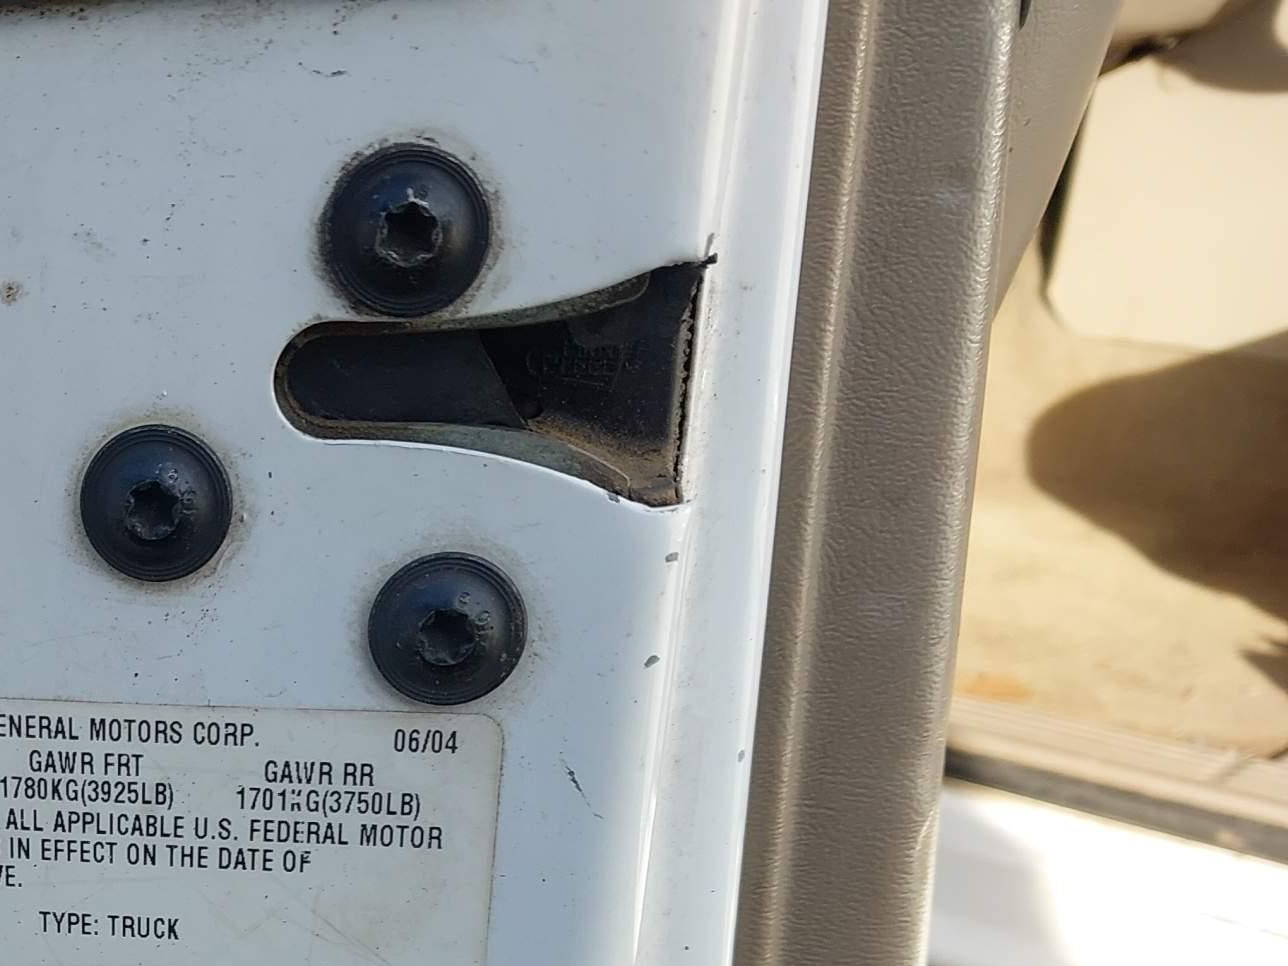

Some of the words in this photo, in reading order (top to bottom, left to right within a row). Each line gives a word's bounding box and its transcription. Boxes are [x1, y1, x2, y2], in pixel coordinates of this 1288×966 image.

[89, 717, 183, 745] MOTORS
[192, 721, 260, 748] CORP.
[393, 728, 459, 755] 06/04
[28, 749, 95, 776] GAWR
[103, 752, 145, 777] FRT
[264, 759, 334, 786] GAWR
[342, 762, 375, 787] RR
[5, 807, 44, 832] ALL
[52, 809, 185, 839] APPLICABLE
[193, 816, 239, 841] U.S.
[249, 818, 350, 846] FEDERAL
[359, 823, 443, 850] MOTOR
[9, 836, 31, 860] IN
[40, 838, 119, 865] EFFECT
[126, 842, 157, 867] ON
[165, 844, 209, 869] THE
[218, 846, 274, 872] DATE
[282, 849, 312, 873] OF
[38, 910, 99, 936] TYPE:
[106, 914, 180, 941] TRUCK
